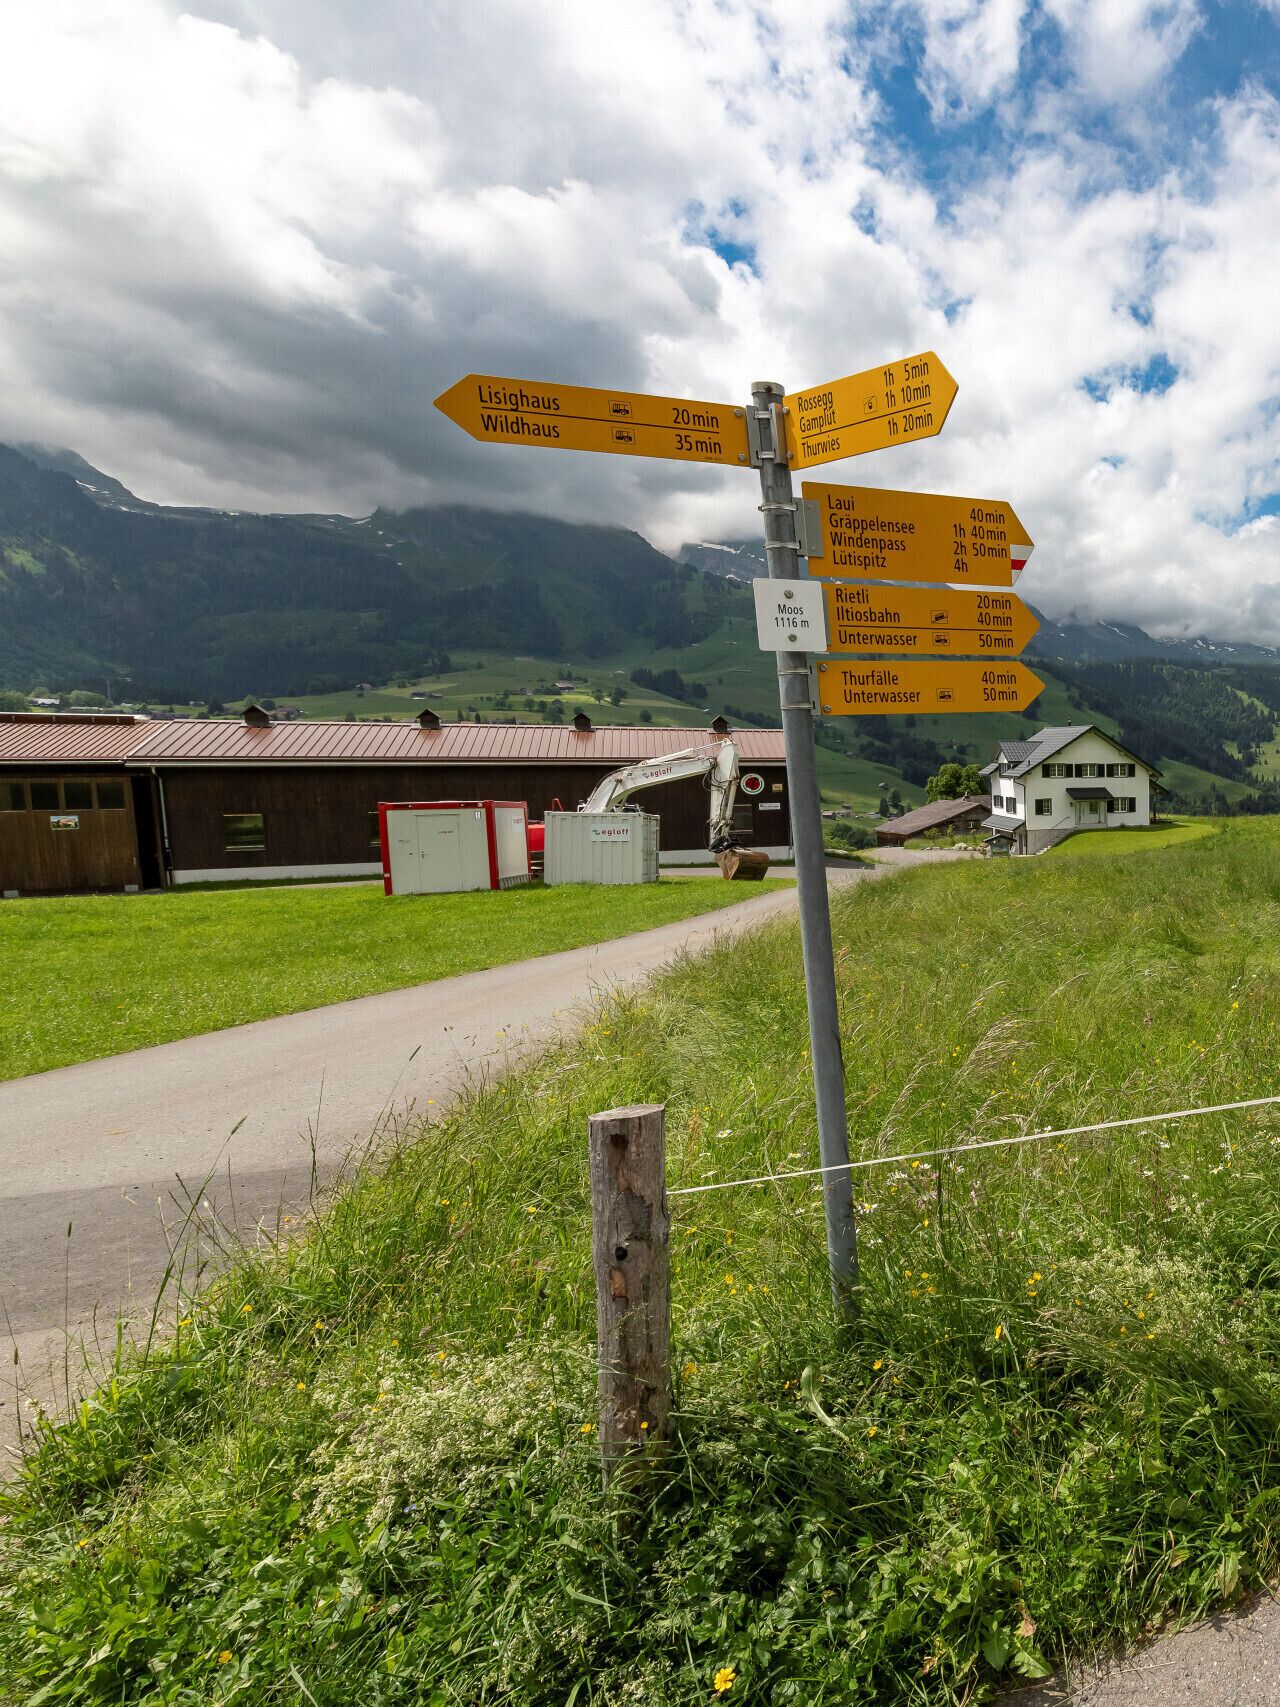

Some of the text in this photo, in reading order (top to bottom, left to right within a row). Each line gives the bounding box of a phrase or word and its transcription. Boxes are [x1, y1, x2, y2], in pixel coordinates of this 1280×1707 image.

[478, 385, 560, 411] Lisighaus
[798, 391, 833, 413] Rossegg
[884, 368, 894, 387] 1h
[800, 409, 836, 433] Gamplüt
[886, 390, 896, 408] 1h
[481, 414, 560, 438] Wildhaus
[802, 436, 840, 459] Thurwies
[888, 420, 898, 436] 1h
[828, 494, 855, 511] Laui
[829, 513, 915, 534] Gräppelensee
[953, 524, 965, 539] 1h
[830, 532, 905, 551] Windenpass
[954, 542, 966, 556] 2h
[833, 551, 968, 572] Lütispitz 4h
[836, 588, 869, 604] Rietli
[778, 604, 803, 615] Moos
[837, 607, 900, 623] Iltiosbahn
[775, 617, 809, 628] 1116 m
[839, 630, 917, 646] Unterwasser
[842, 671, 898, 686] Thurfälle
[844, 689, 920, 703] Unterwasser
[650, 767, 672, 777] egloff
